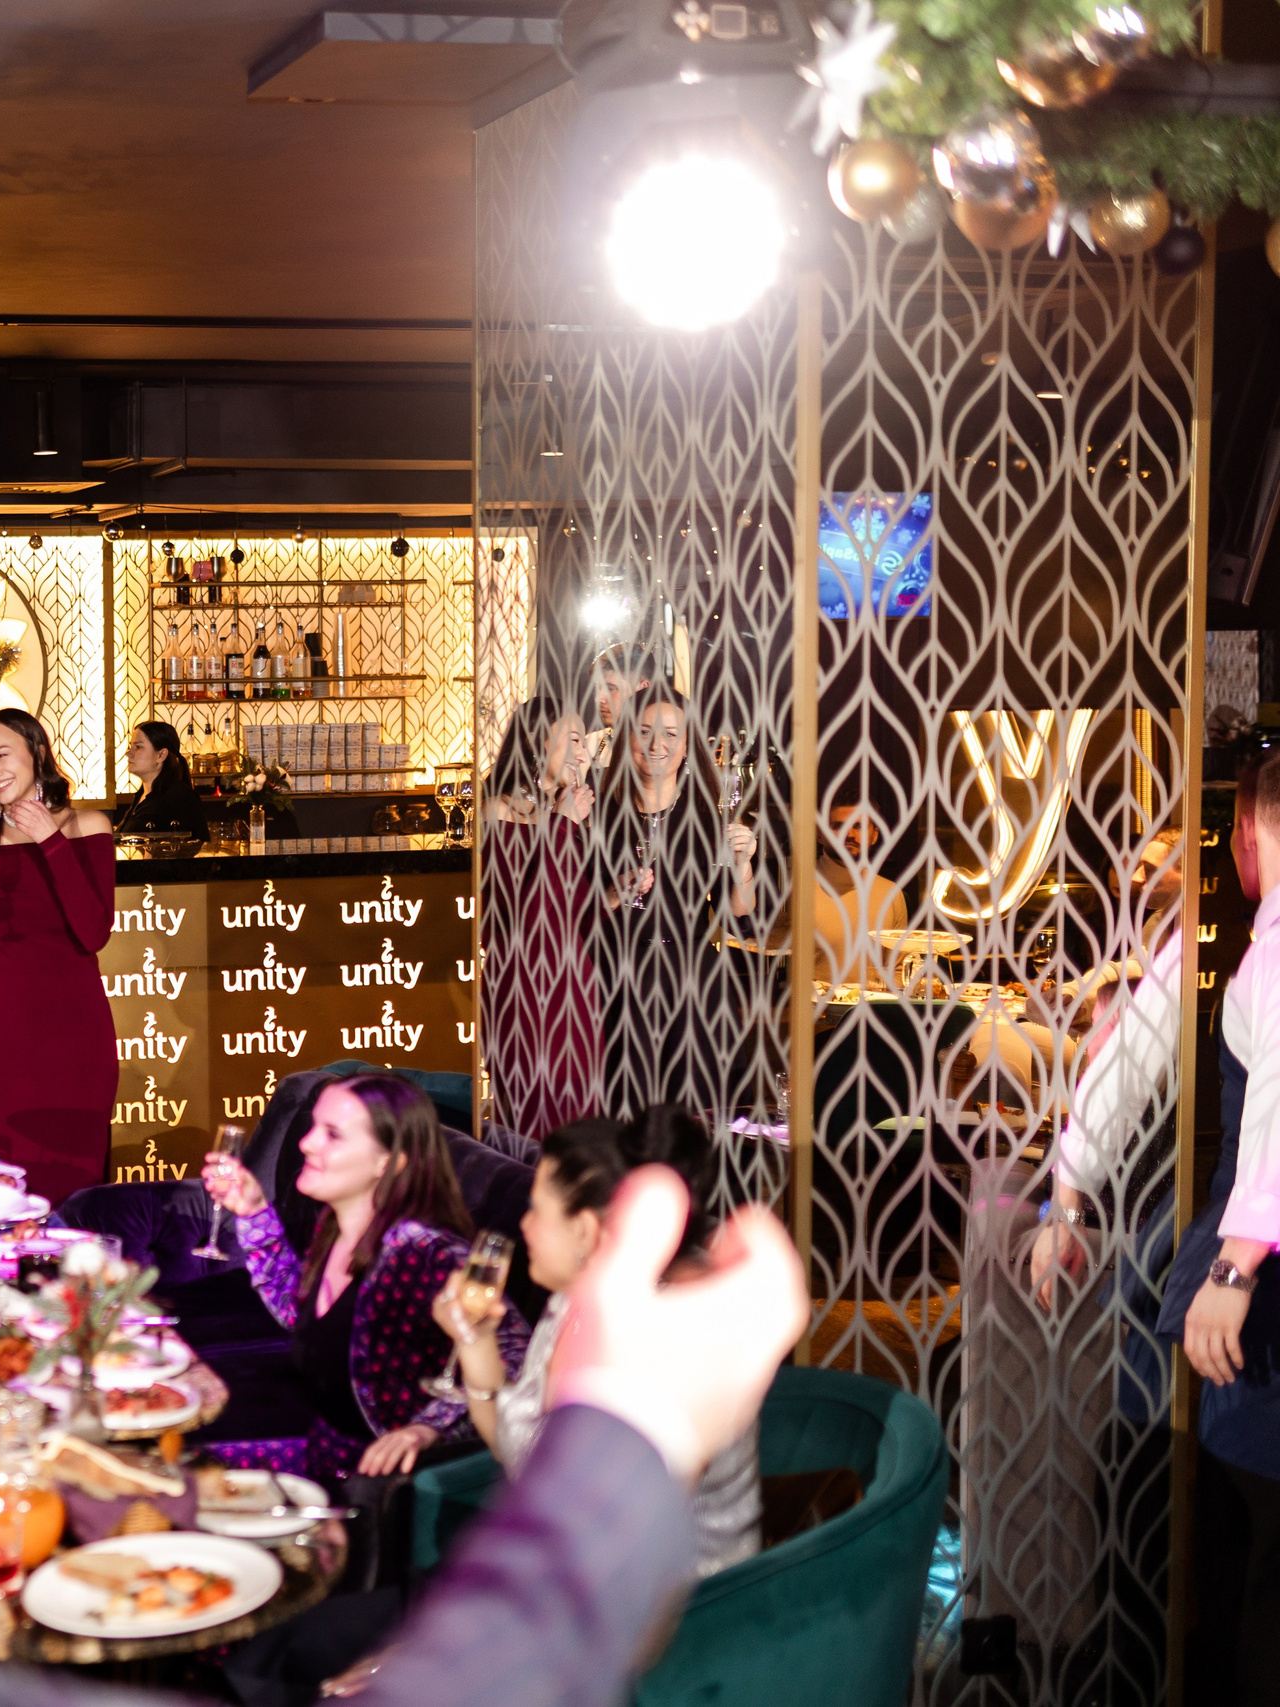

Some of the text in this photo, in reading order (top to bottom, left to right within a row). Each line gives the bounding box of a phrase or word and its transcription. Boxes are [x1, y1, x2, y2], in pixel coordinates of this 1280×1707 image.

[221, 880, 305, 931] unity
[340, 875, 423, 926] unity
[100, 947, 187, 999] unity
[221, 942, 306, 994] unity
[340, 938, 423, 989] unity
[222, 1007, 306, 1057] unity
[340, 1001, 423, 1051] unity
